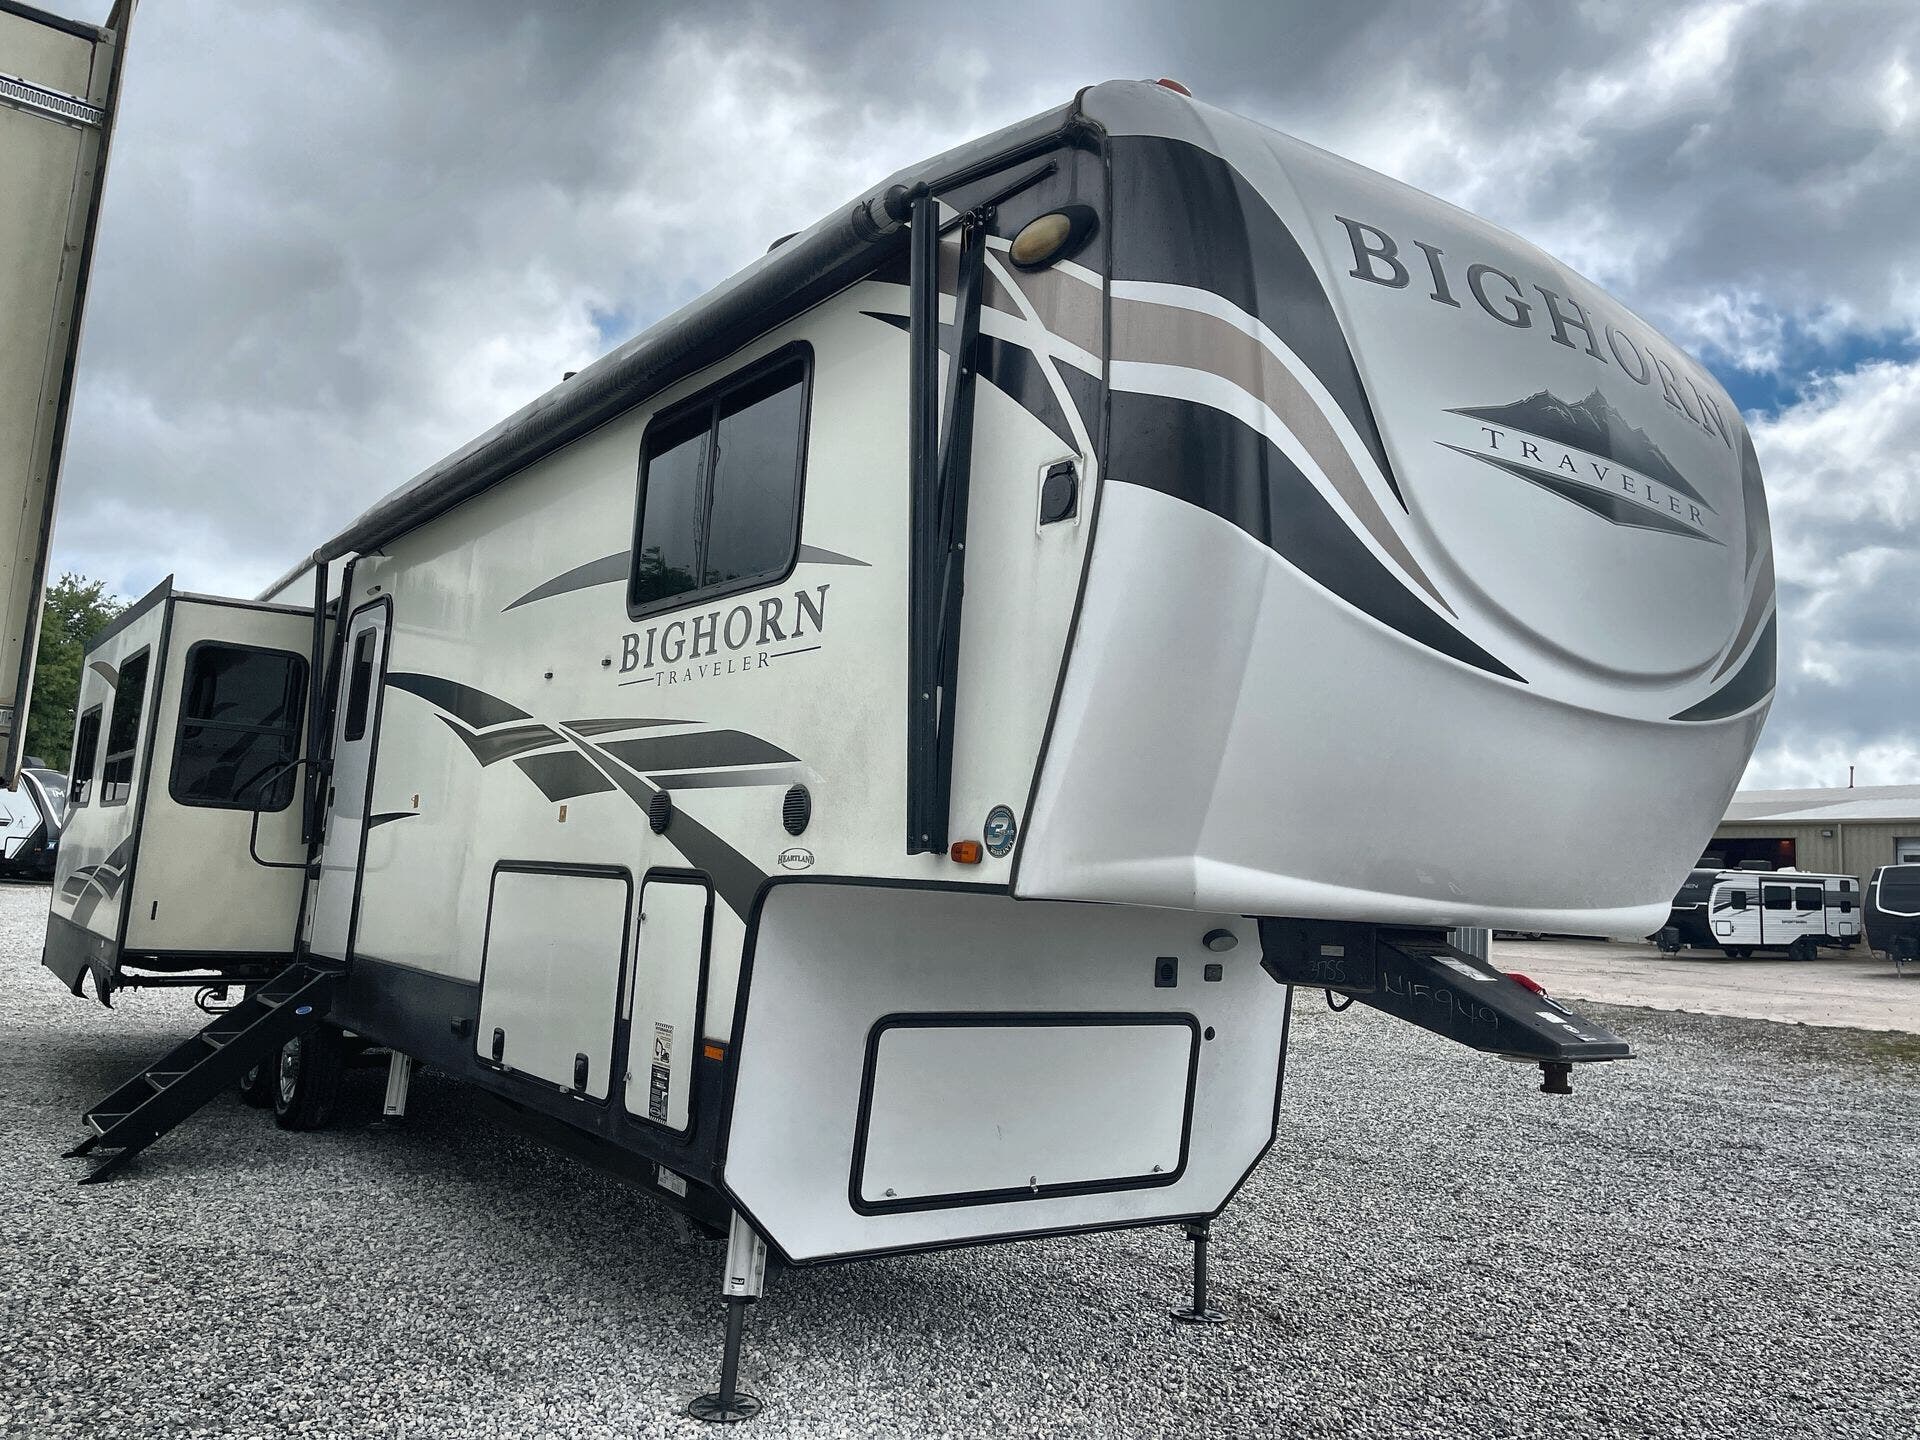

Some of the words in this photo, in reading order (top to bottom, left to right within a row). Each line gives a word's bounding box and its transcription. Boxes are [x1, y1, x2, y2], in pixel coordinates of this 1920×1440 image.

[1334, 214, 1732, 450] BIGHORN
[1481, 427, 1704, 526] TRAVELER
[618, 583, 831, 674] BIGHORN
[655, 651, 769, 687] TRAVELER
[777, 854, 815, 865] HEARTLAND
